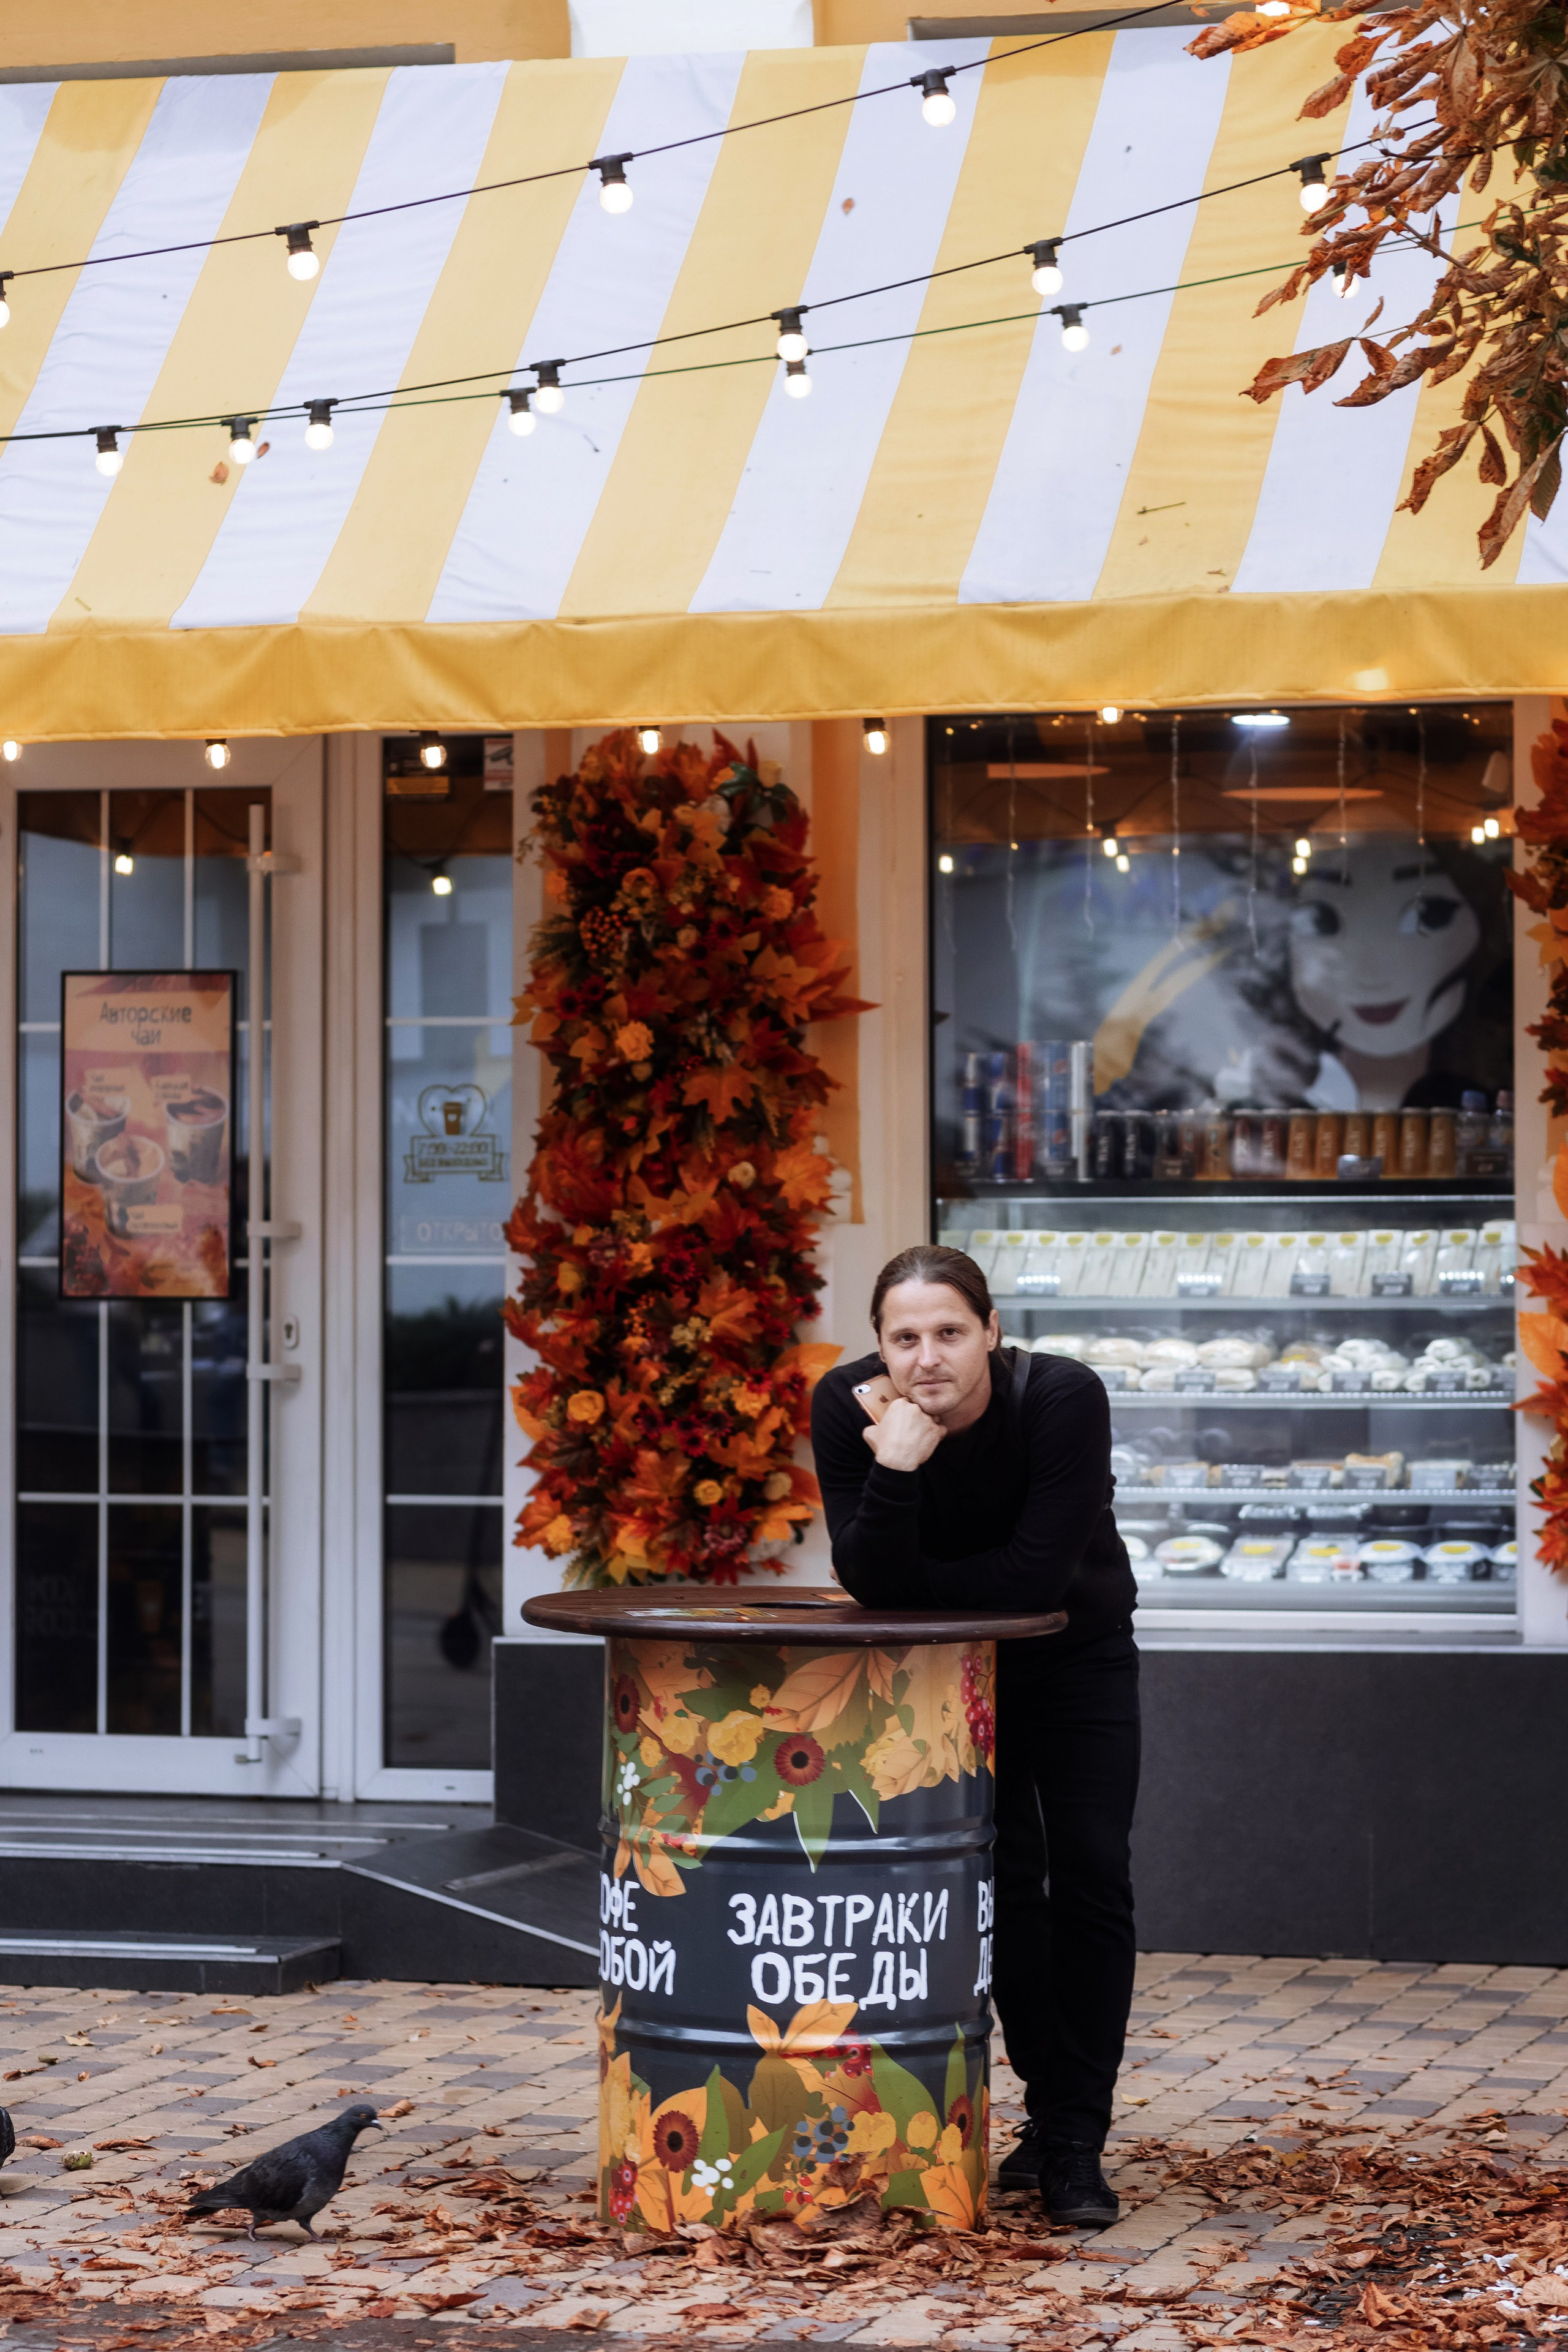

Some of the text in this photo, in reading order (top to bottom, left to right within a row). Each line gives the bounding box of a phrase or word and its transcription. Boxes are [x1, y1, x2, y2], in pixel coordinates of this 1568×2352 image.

[100, 1001, 192, 1029] Авторские
[600, 1871, 640, 1932] ОФЕ
[726, 1888, 948, 1947] ЗАВТРАКИ
[598, 1928, 676, 1996] ОБОЙ
